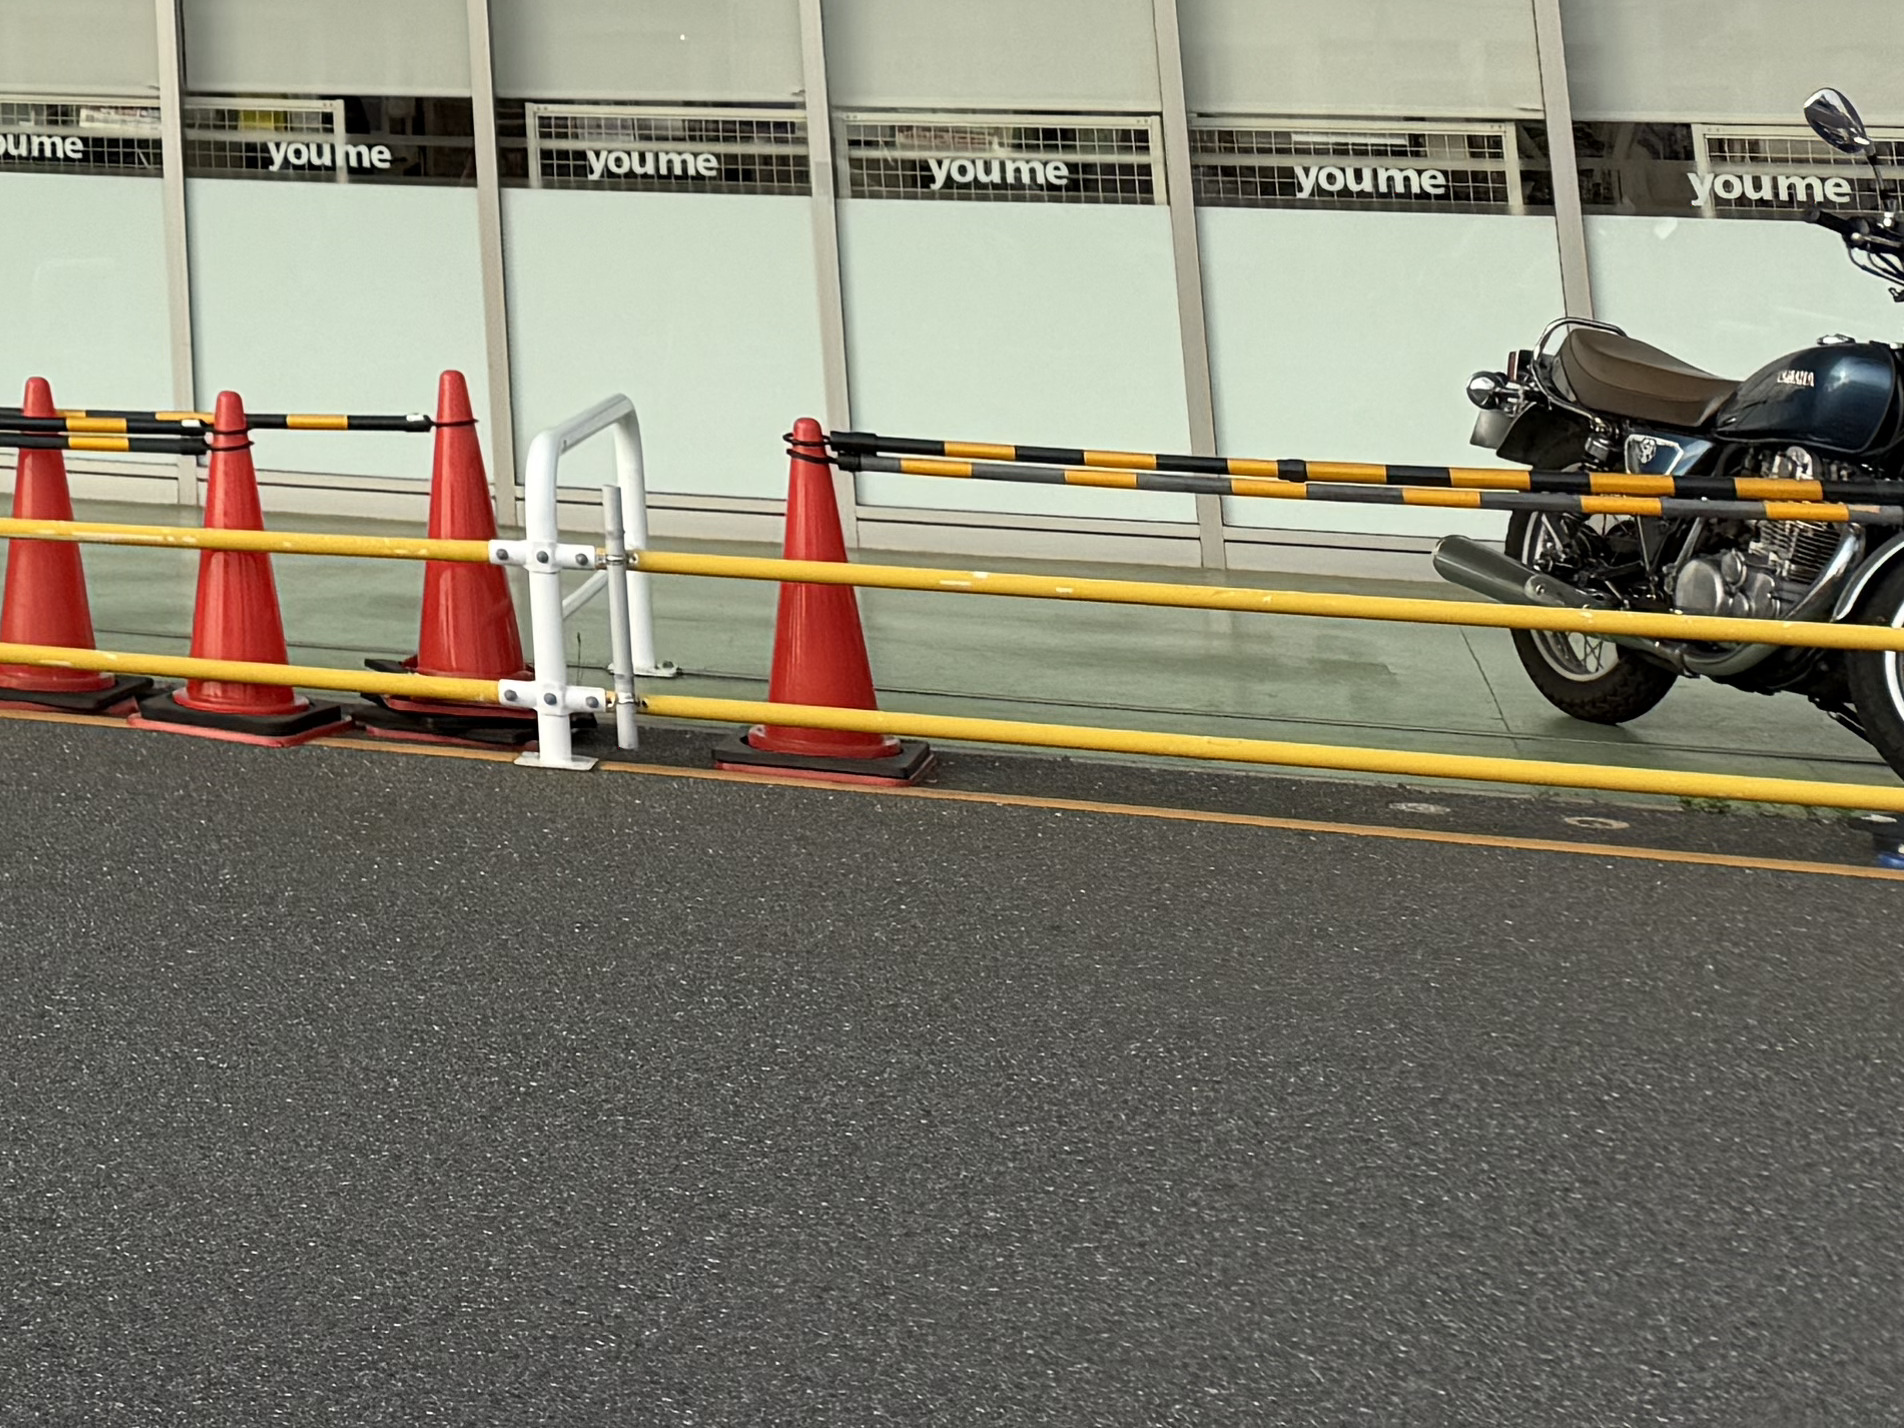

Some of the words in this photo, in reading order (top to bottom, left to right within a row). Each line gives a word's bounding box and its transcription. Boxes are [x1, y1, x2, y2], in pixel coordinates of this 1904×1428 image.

[266, 141, 392, 171] youme
[586, 148, 719, 180] youme
[928, 157, 1070, 190] youme
[1294, 165, 1447, 198] youme
[1686, 172, 1853, 206] youme
